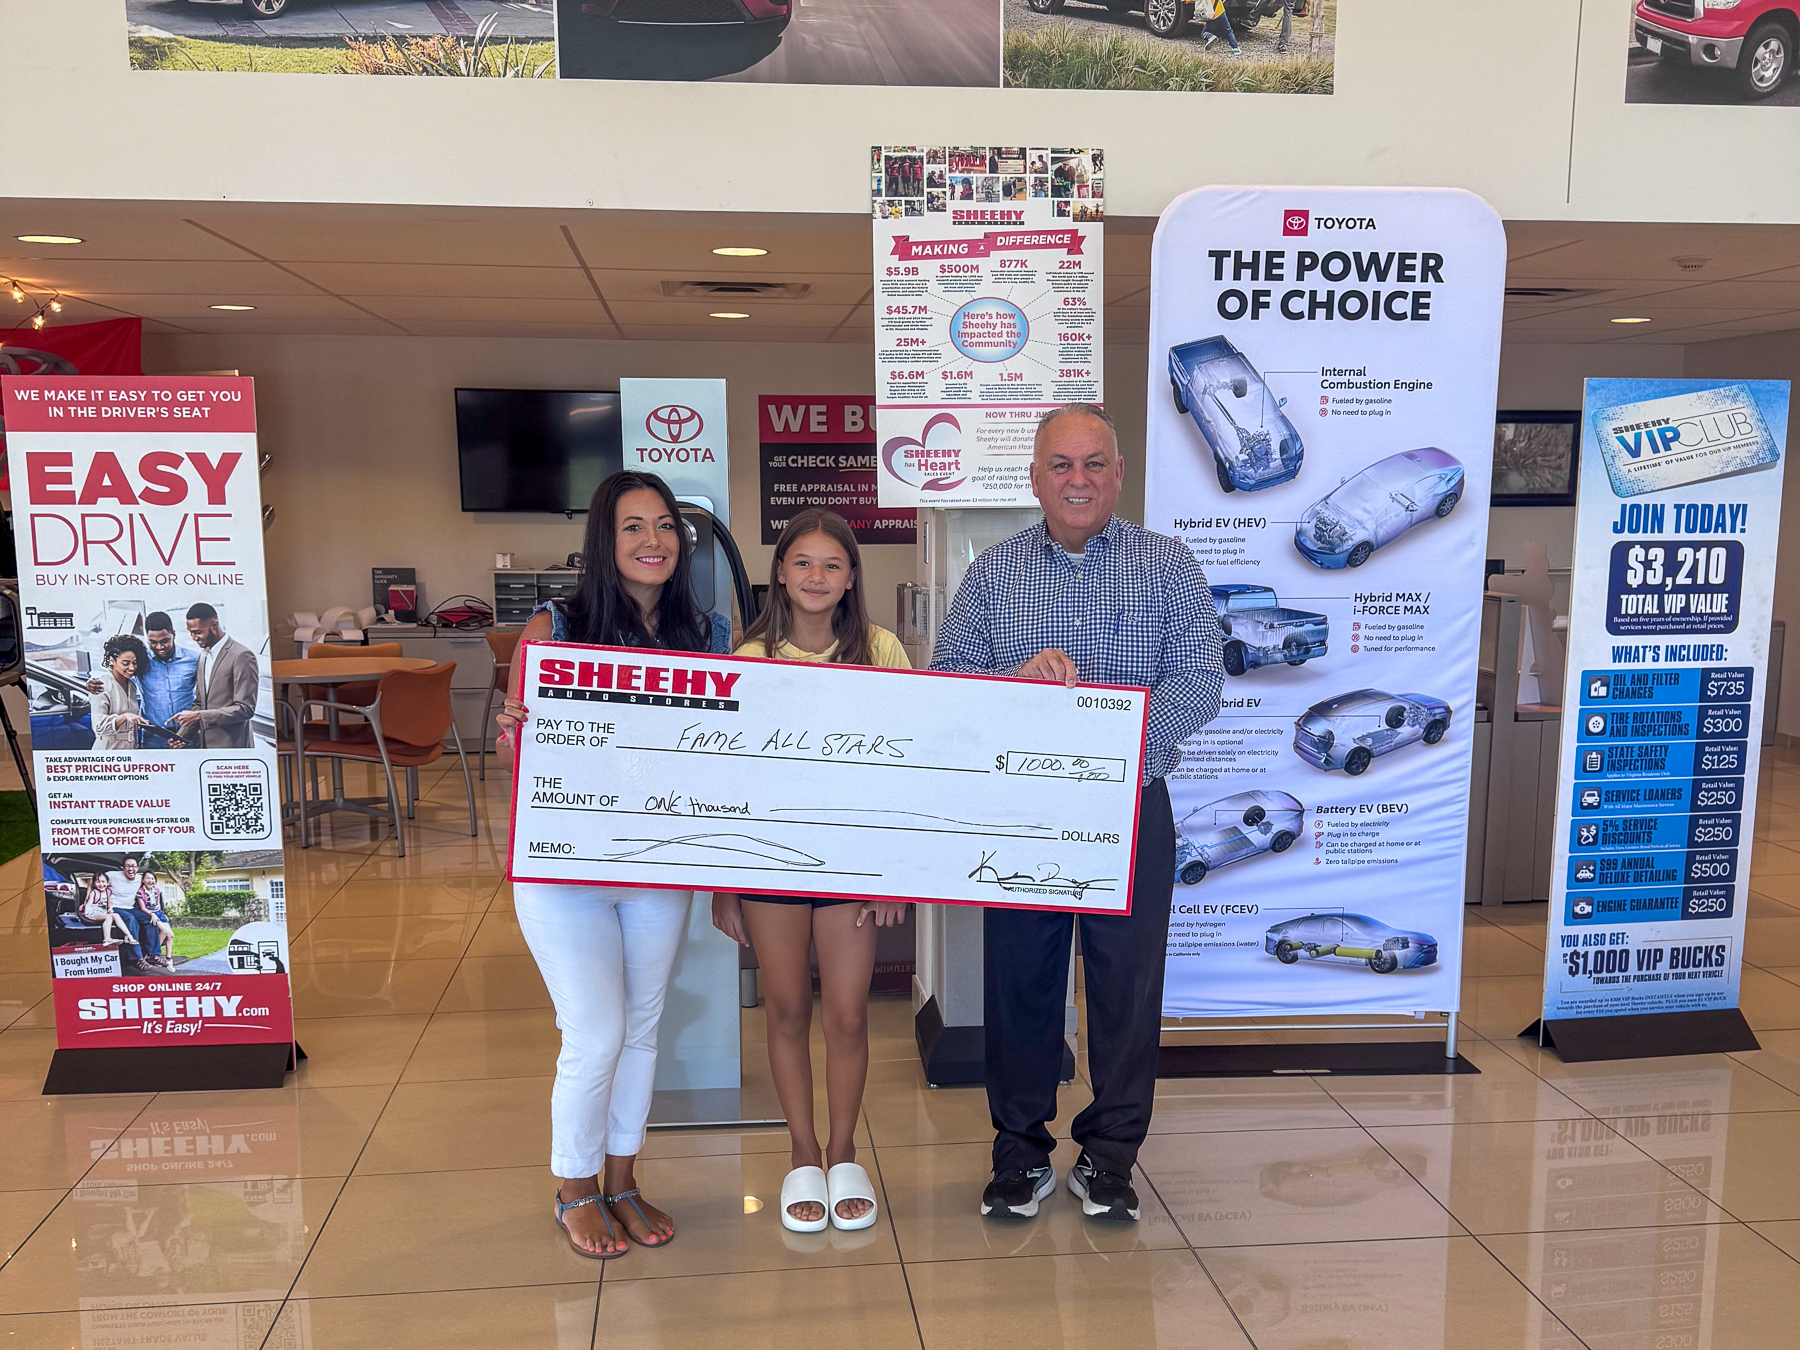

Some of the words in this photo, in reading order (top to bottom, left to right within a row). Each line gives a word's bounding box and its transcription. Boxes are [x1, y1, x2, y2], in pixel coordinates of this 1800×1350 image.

[952, 210, 1024, 220] SHEEHY
[1315, 218, 1376, 229] TOYOTA
[912, 244, 968, 256] MAKING
[997, 234, 1071, 245] DIFFERENCE
[940, 264, 979, 274] $500M
[1000, 260, 1028, 268] 877K
[1059, 261, 1081, 269] 22M
[1208, 250, 1285, 281] THE
[1296, 251, 1444, 283] POWER
[886, 267, 919, 276] $5.9B
[1063, 297, 1086, 306] 63%
[1217, 289, 1271, 320] OF
[1280, 290, 1431, 321] CHOICE
[887, 305, 927, 315] $45.7M
[962, 321, 997, 330] Sheehy
[957, 330, 1003, 339] Impacted
[1006, 330, 1021, 338] the
[1058, 333, 1092, 341] 160K+
[896, 338, 926, 346] 25M+
[962, 340, 1017, 349] Community
[890, 371, 924, 380] $6.6M
[942, 371, 973, 380] $1.6M
[999, 373, 1022, 381] 1.5M
[1059, 369, 1091, 377] 381K+
[1322, 366, 1366, 376] Internal
[1321, 379, 1390, 389] Combustion
[1394, 379, 1432, 391] Engine
[14, 390, 39, 400] WE
[44, 390, 86, 400] MAKE
[91, 390, 104, 401] IT
[109, 390, 147, 401] EASY
[151, 391, 172, 401] TO
[177, 391, 205, 401] GET
[209, 391, 241, 401] YOU
[49, 407, 63, 417] IN
[68, 407, 97, 417] THE
[102, 407, 168, 417] DRIVER'S
[174, 407, 210, 418] SEAT
[767, 405, 827, 432] WE
[1612, 417, 1672, 435] SHEEHY
[636, 448, 715, 462] TOYOTA
[904, 450, 961, 458] SHEEHY
[788, 456, 835, 467] CHECK
[918, 459, 960, 471] Heart
[26, 451, 242, 506] EASY
[774, 484, 797, 492] FREE
[800, 484, 855, 492] APPRAISAL
[1175, 518, 1212, 530] Hybrid
[1216, 518, 1230, 527] EV
[1233, 518, 1266, 529] (HEV)
[1613, 504, 1665, 534] JOIN
[1674, 504, 1748, 533] TODAY!
[30, 513, 236, 566] DRIVE
[1627, 545, 1726, 591] $3,210
[36, 574, 68, 585] BUY
[74, 574, 150, 585] IN-STORE
[155, 574, 178, 585] OR
[184, 574, 243, 585] ONLINE
[1355, 592, 1392, 604] Hybrid
[1396, 593, 1422, 602] MAX
[1621, 594, 1659, 614] TOTAL
[1664, 594, 1685, 613] VIP
[1690, 594, 1728, 613] VALUE
[1354, 606, 1400, 615] i-FORCE
[1404, 605, 1429, 614] MAX
[1612, 645, 1660, 663] WHAT'S
[1665, 644, 1728, 662] INCLUDED:
[538, 658, 742, 698] SHEEHY
[1707, 681, 1744, 697] $735
[547, 689, 610, 701] AUTO
[630, 695, 725, 709] STORES
[1077, 696, 1131, 710] 0010392
[537, 719, 562, 730] PAY
[566, 720, 584, 731] TO
[588, 722, 615, 734] THE
[1703, 718, 1742, 734] $300
[536, 733, 586, 746] ORDER
[589, 736, 608, 747] OF
[677, 722, 746, 751] FAME
[762, 729, 810, 751] ALL
[822, 734, 913, 758] STARS
[1702, 754, 1737, 770] $125
[46, 765, 72, 773] BEST
[75, 765, 121, 773] PRICING
[124, 764, 175, 772] UPFRONT
[533, 777, 562, 789] THE
[532, 792, 595, 805] AMOUNT
[600, 795, 619, 806] OF
[1605, 789, 1643, 802] SERVICE
[1644, 788, 1682, 801] LOANERS
[1698, 791, 1735, 806] $250
[50, 800, 96, 809] INSTANT
[98, 800, 134, 808] TRADE
[136, 799, 170, 807] VALUE
[645, 791, 682, 815] ONE
[688, 797, 751, 817] thousand
[1316, 804, 1356, 815] Battery
[1360, 804, 1373, 813] EV
[1377, 804, 1408, 814] (BEV)
[53, 837, 85, 845] HOME
[88, 837, 104, 845] OR
[107, 836, 144, 845] OFFICE
[1062, 831, 1119, 843] DOLLARS
[1695, 827, 1732, 842] $250
[530, 842, 575, 854] MEMO:
[1691, 863, 1729, 878] $500
[1179, 904, 1200, 914] Cell
[1204, 905, 1219, 914] EV
[1221, 904, 1258, 915] (FCEV)
[1689, 898, 1726, 914] $250
[1561, 935, 1579, 948] YOU
[1582, 933, 1606, 946] ALSO
[1609, 932, 1629, 945] GET:
[60, 956, 89, 966] Bought
[91, 956, 102, 964] My
[104, 953, 118, 963] Car
[1568, 949, 1629, 979] $1,000
[1637, 948, 1663, 971] VIP
[1669, 945, 1725, 969] BUCKS
[64, 968, 85, 976] From
[87, 966, 112, 974] Home!
[113, 984, 145, 992] SHOP
[148, 983, 192, 991] ONLINE
[196, 982, 221, 990] 24/7
[143, 1021, 162, 1033] It's
[166, 1020, 202, 1035] Easy!
